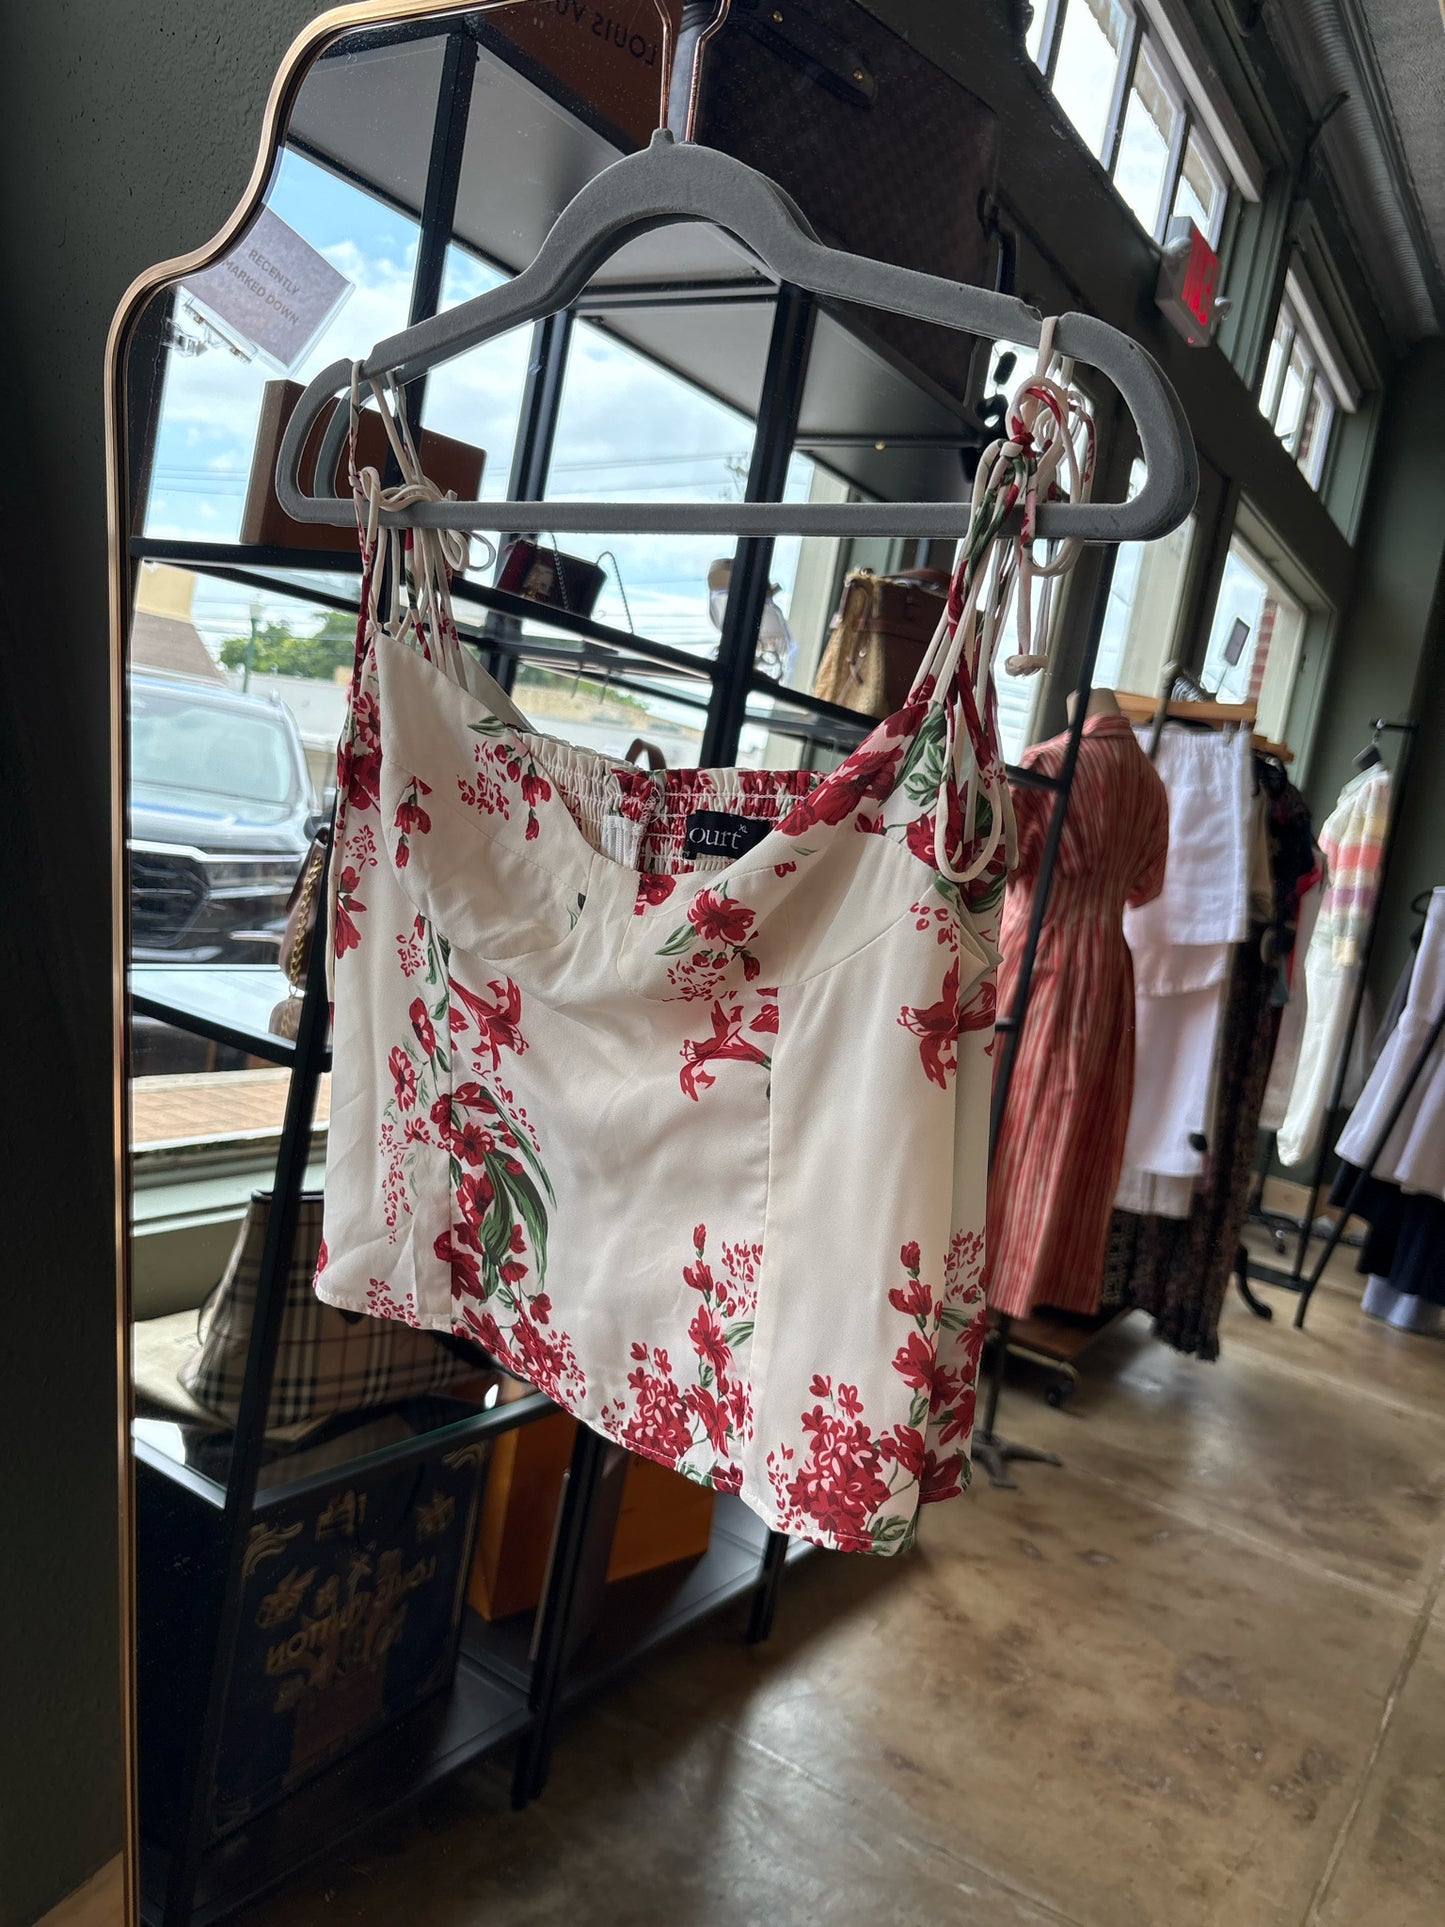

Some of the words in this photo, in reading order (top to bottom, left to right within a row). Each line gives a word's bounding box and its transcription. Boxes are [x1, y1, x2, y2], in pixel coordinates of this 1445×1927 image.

[222, 258, 266, 298] MARKED
[265, 293, 300, 325] DOWN
[248, 248, 300, 296] RECENTLY
[688, 827, 742, 850] ourt
